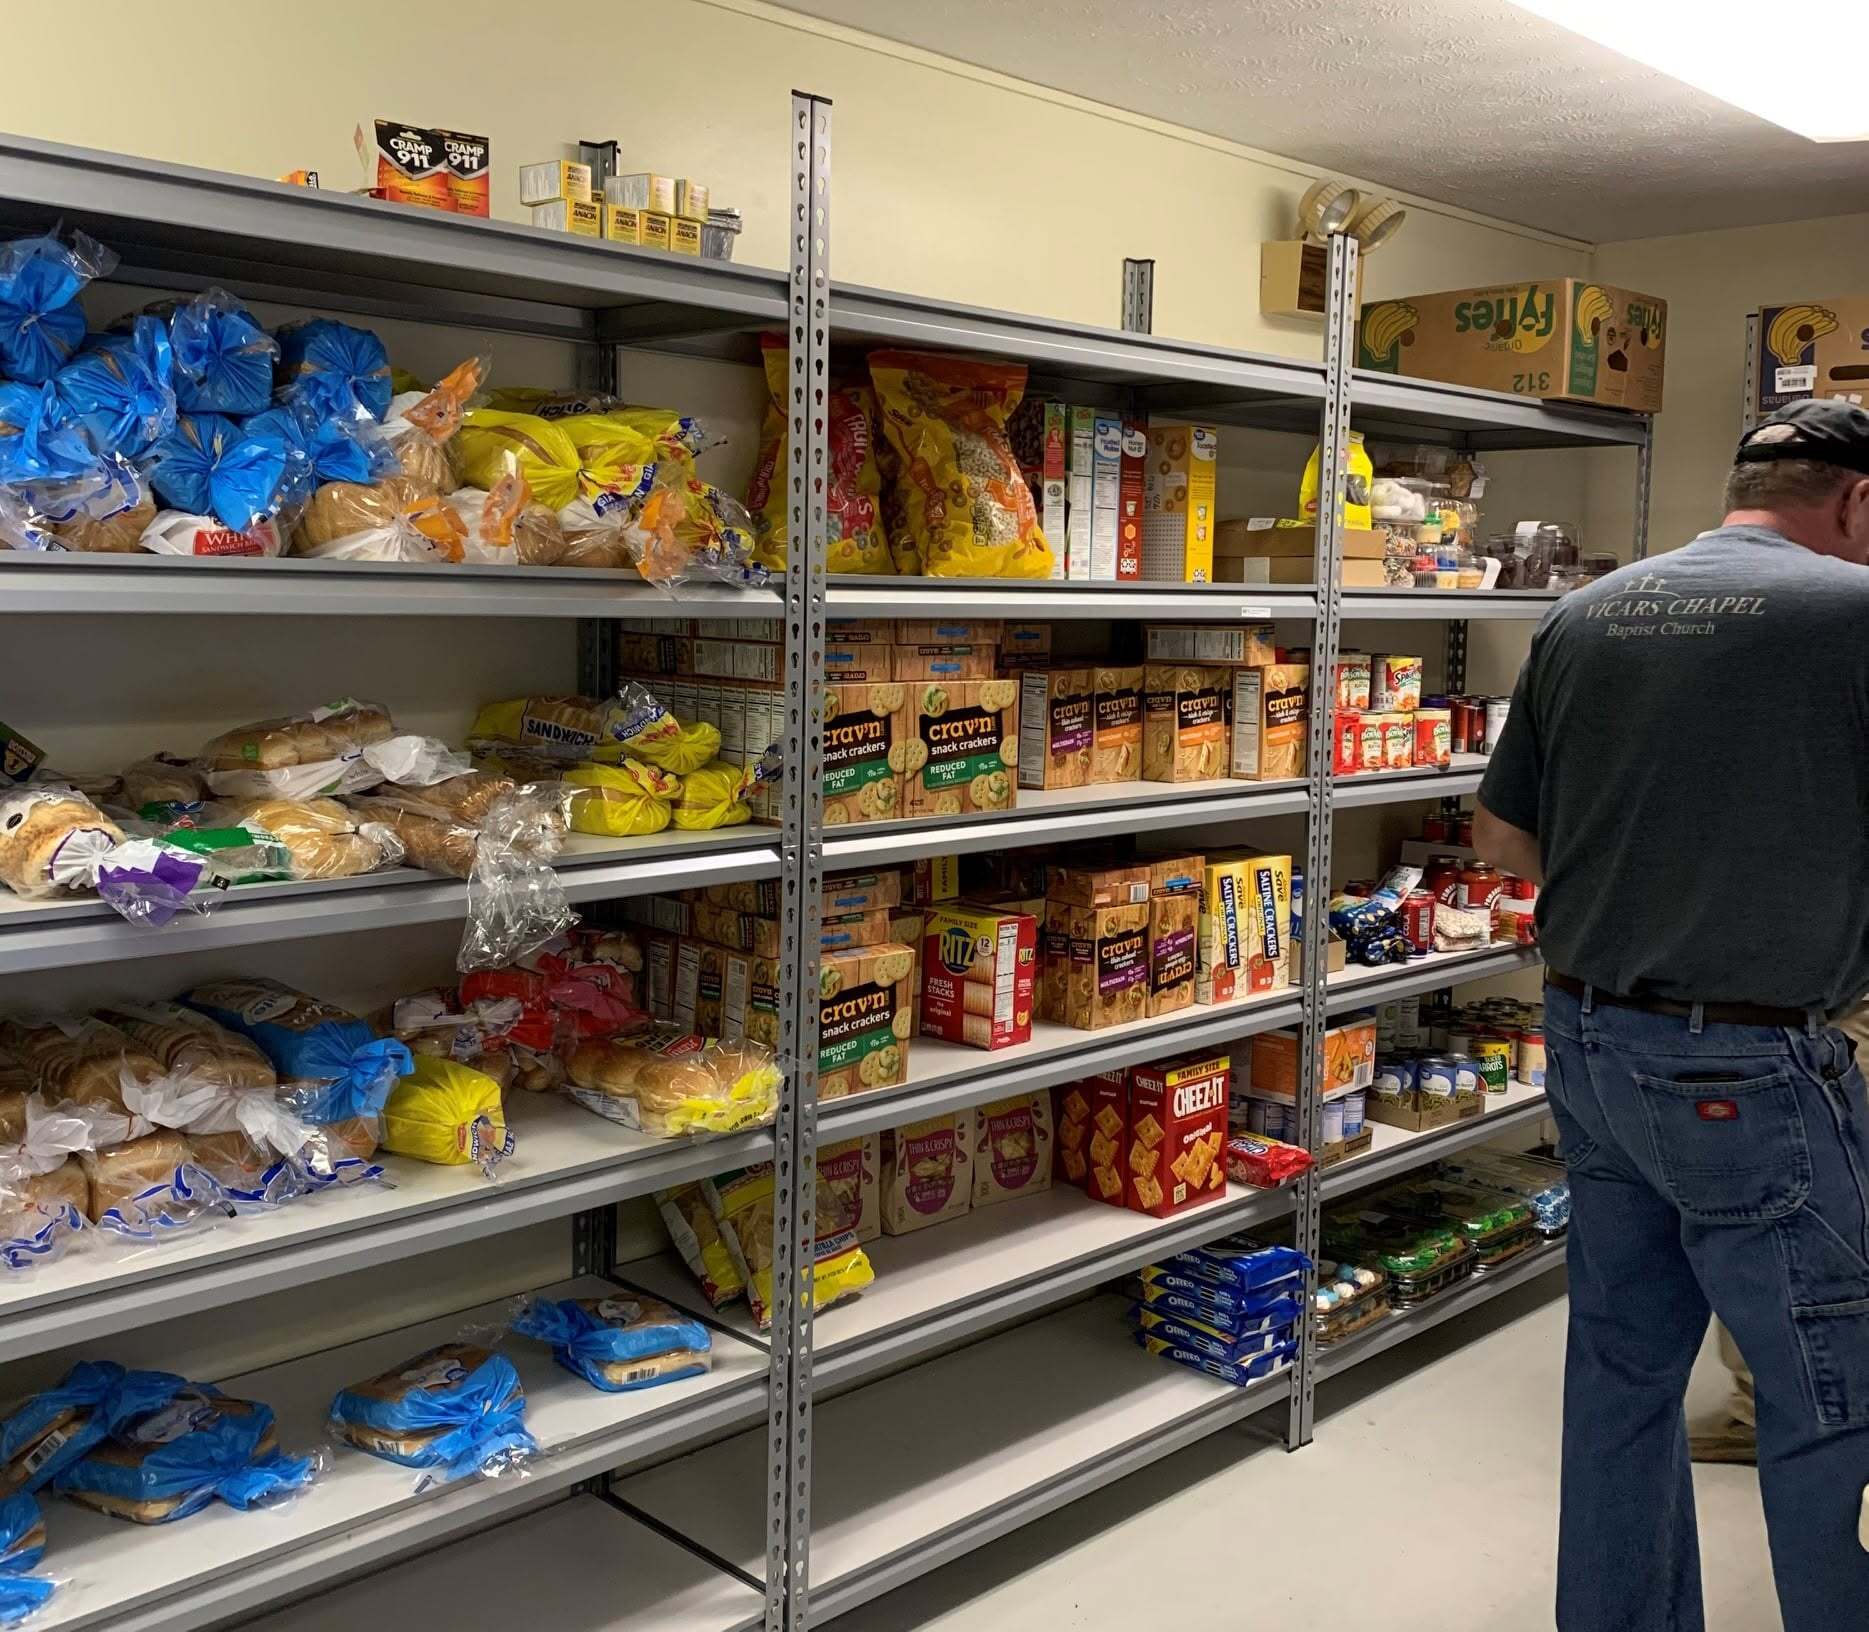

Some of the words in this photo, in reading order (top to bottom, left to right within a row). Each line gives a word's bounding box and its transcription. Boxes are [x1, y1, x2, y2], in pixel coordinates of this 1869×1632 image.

[389, 138, 432, 156] CRAMP
[444, 141, 484, 157] CRAMP
[396, 150, 430, 169] 911
[448, 152, 478, 170] 911
[572, 209, 597, 221] ANACIN
[614, 218, 638, 228] ANACIN
[676, 229, 698, 240] ANACIN
[1512, 371, 1551, 393] 312
[1585, 600, 1665, 620] VICARS
[1667, 597, 1768, 616] CHAPEL
[1606, 623, 1656, 640] Baptist
[1660, 621, 1715, 636] Church
[929, 716, 992, 741] crav'n
[823, 748, 848, 762] snack
[849, 741, 886, 757] crackers
[931, 743, 958, 756] snack
[959, 736, 997, 750] crackers
[930, 761, 966, 774] REDUCED
[942, 772, 956, 781] FAT
[831, 780, 845, 789] FAT
[1260, 870, 1274, 909] SALTINE
[1274, 870, 1285, 902] Save
[1222, 877, 1235, 918] SALTINE
[939, 916, 962, 928] FAMILY
[963, 920, 978, 930] SIZE
[1403, 913, 1411, 937] COLA
[1264, 908, 1278, 957] CRACKERS
[938, 930, 976, 968] RITZ
[979, 937, 990, 948] 12
[1226, 918, 1239, 966] CRACKERS
[1018, 947, 1034, 963] RITZ
[927, 984, 955, 998] STACKS
[929, 977, 953, 989] FRESH
[820, 990, 885, 1024] crav'n
[929, 1006, 952, 1017] original
[821, 1022, 849, 1039] snack
[850, 1011, 890, 1031] crackers
[820, 1040, 858, 1059] REDUCED
[832, 1052, 846, 1063] FAT
[1177, 1064, 1204, 1081] FAMILY
[1205, 1061, 1219, 1073] SIZE
[1480, 1060, 1504, 1072] ARROTS
[1136, 1075, 1164, 1094] CHEEZ-IT
[1173, 1076, 1225, 1118] CHEEZ-IT
[1010, 1115, 1031, 1129] CRISPY
[909, 1142, 925, 1155] THIN
[929, 1137, 953, 1152] CRISPY
[839, 1158, 861, 1174] CRISPY
[1175, 1252, 1201, 1265] OREO
[1166, 1275, 1194, 1290] OREO
[1168, 1296, 1195, 1310] OREO
[1165, 1324, 1190, 1338] OREO
[1173, 1349, 1200, 1362] OREO
